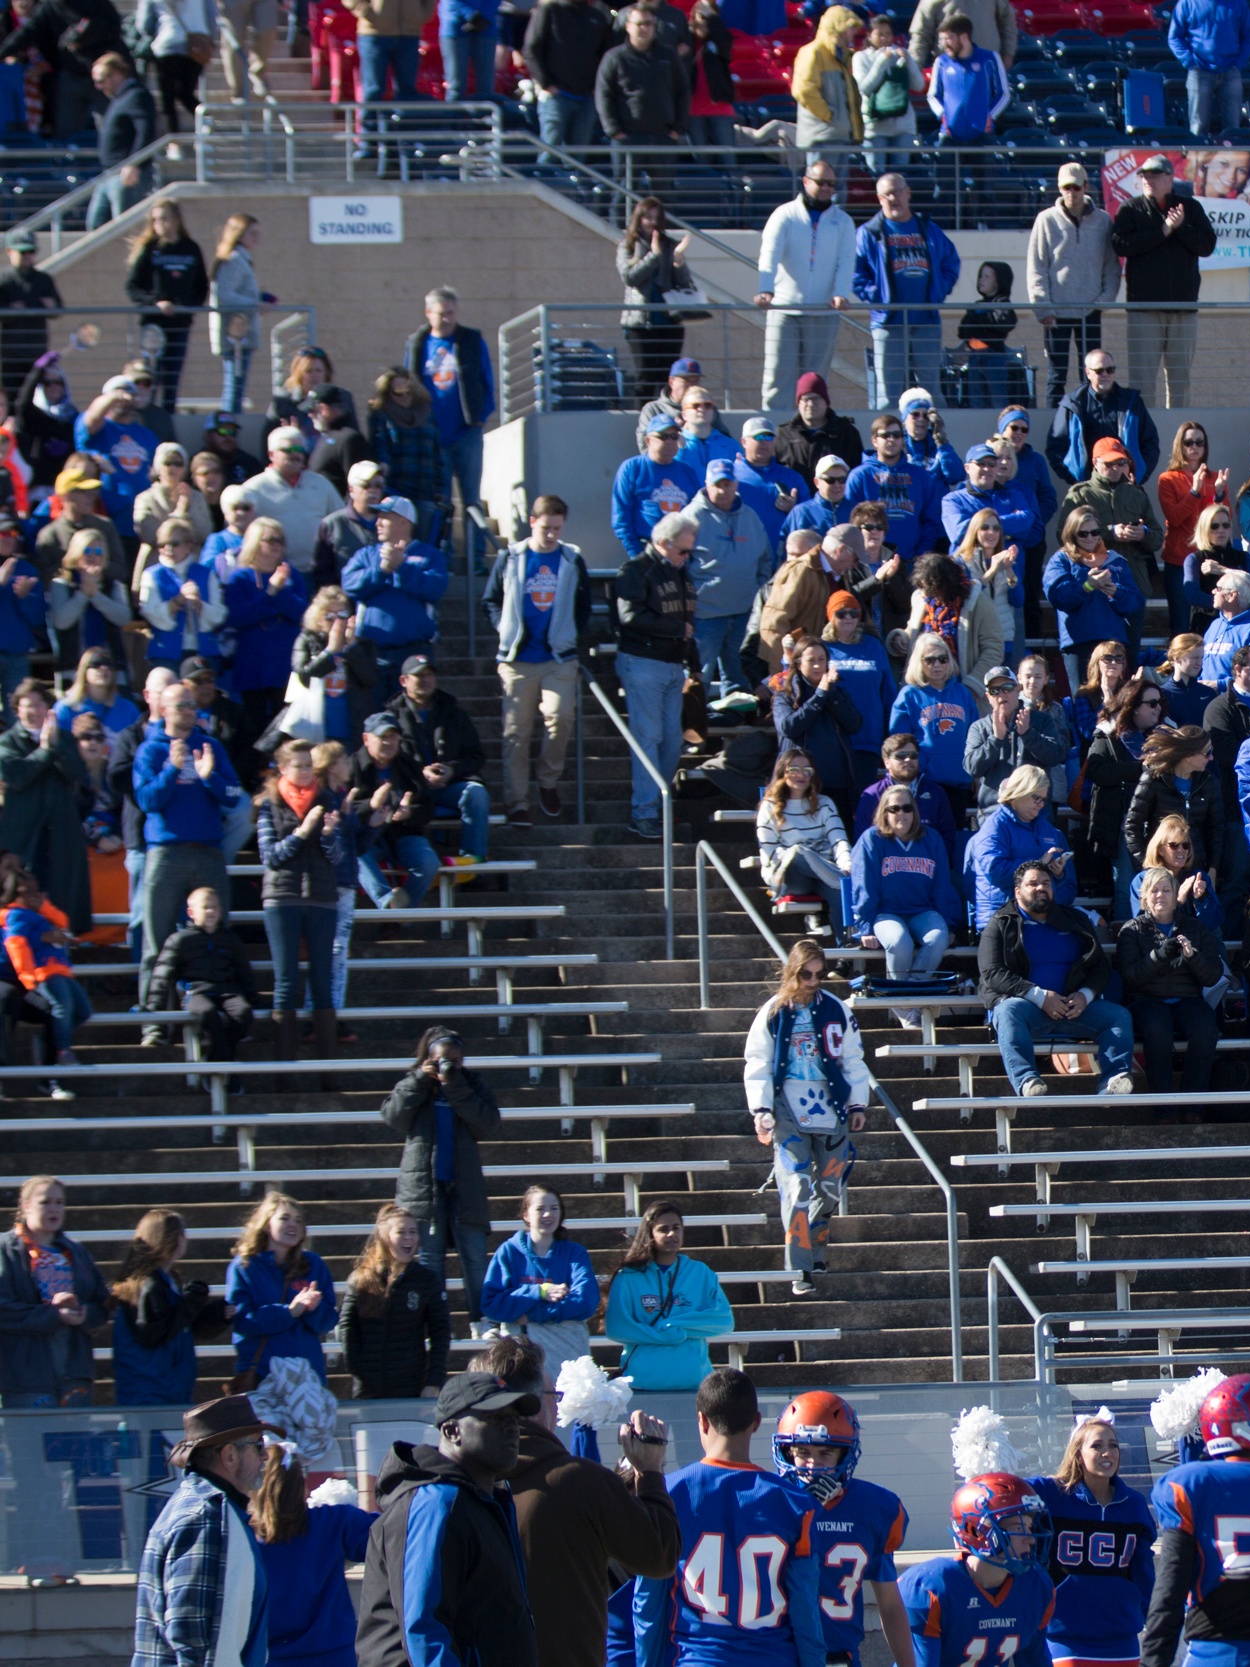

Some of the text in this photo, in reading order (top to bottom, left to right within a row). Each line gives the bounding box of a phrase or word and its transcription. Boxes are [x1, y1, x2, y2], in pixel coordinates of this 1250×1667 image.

[1103, 153, 1137, 184] NEW
[344, 204, 367, 216] NO
[1208, 211, 1245, 224] SKIP
[318, 222, 394, 235] STANDING
[1216, 228, 1231, 237] UY
[881, 855, 935, 879] COVENANT
[682, 1532, 789, 1630] 40
[978, 1617, 1017, 1630] COVENANT
[963, 1635, 1021, 1667] 11
